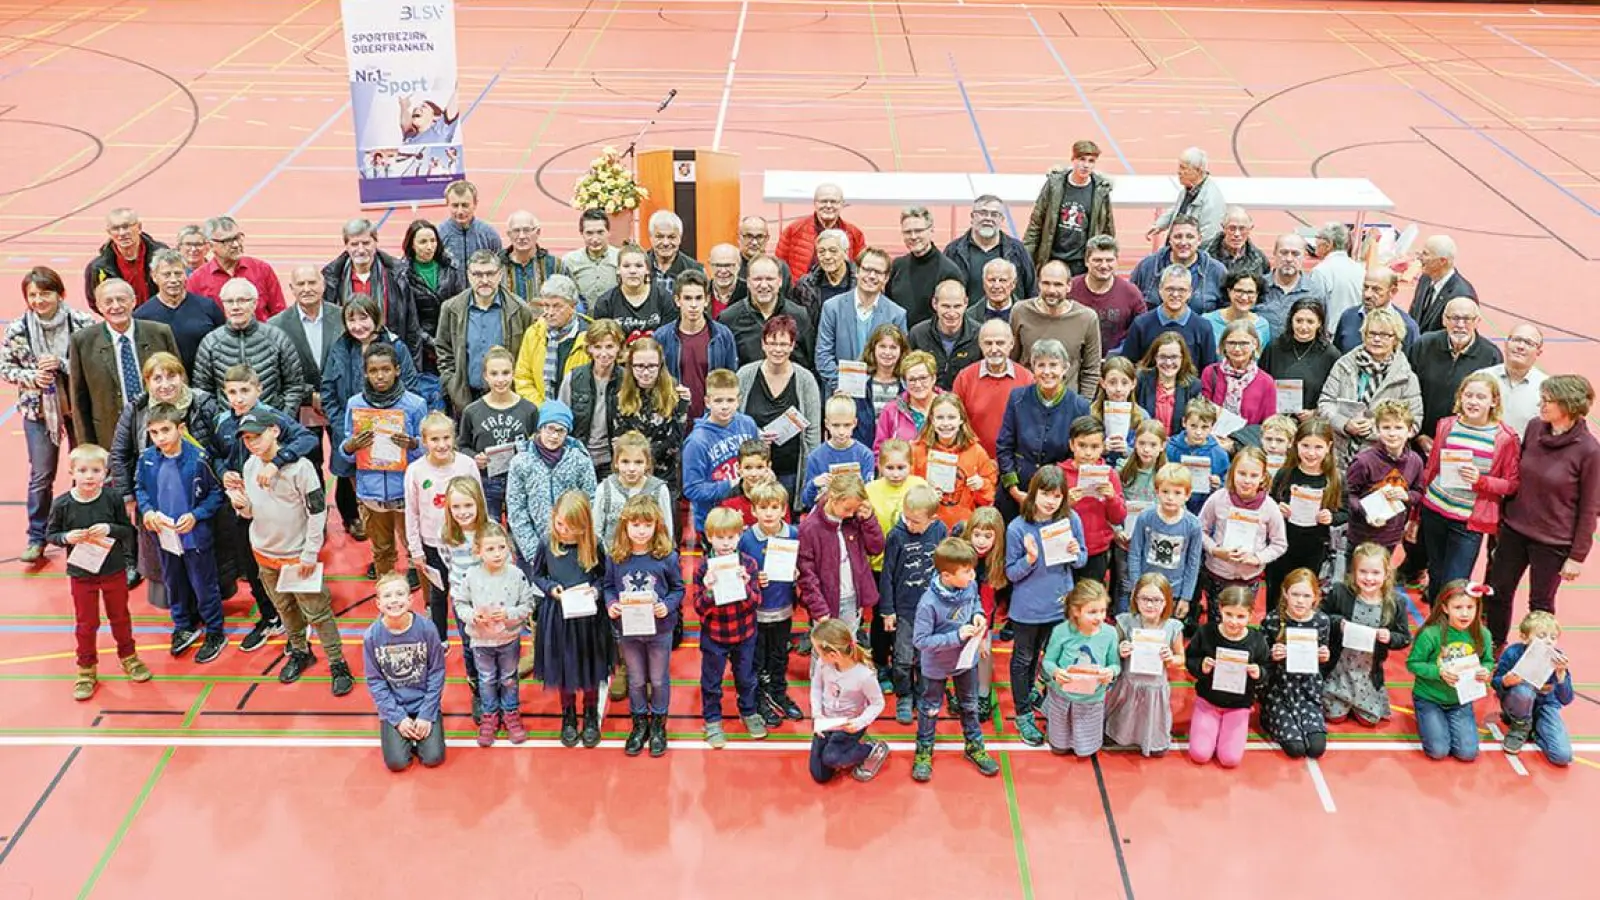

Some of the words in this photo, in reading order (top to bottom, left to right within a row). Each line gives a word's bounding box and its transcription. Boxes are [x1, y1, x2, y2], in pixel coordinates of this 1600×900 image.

[352, 31, 428, 43] SPORTBEZIRK
[352, 42, 434, 54] OBERFRANKEN
[355, 69, 382, 82] Nr.1
[377, 76, 428, 96] Sport
[481, 413, 523, 432] FRESH
[493, 428, 511, 439] OUT
